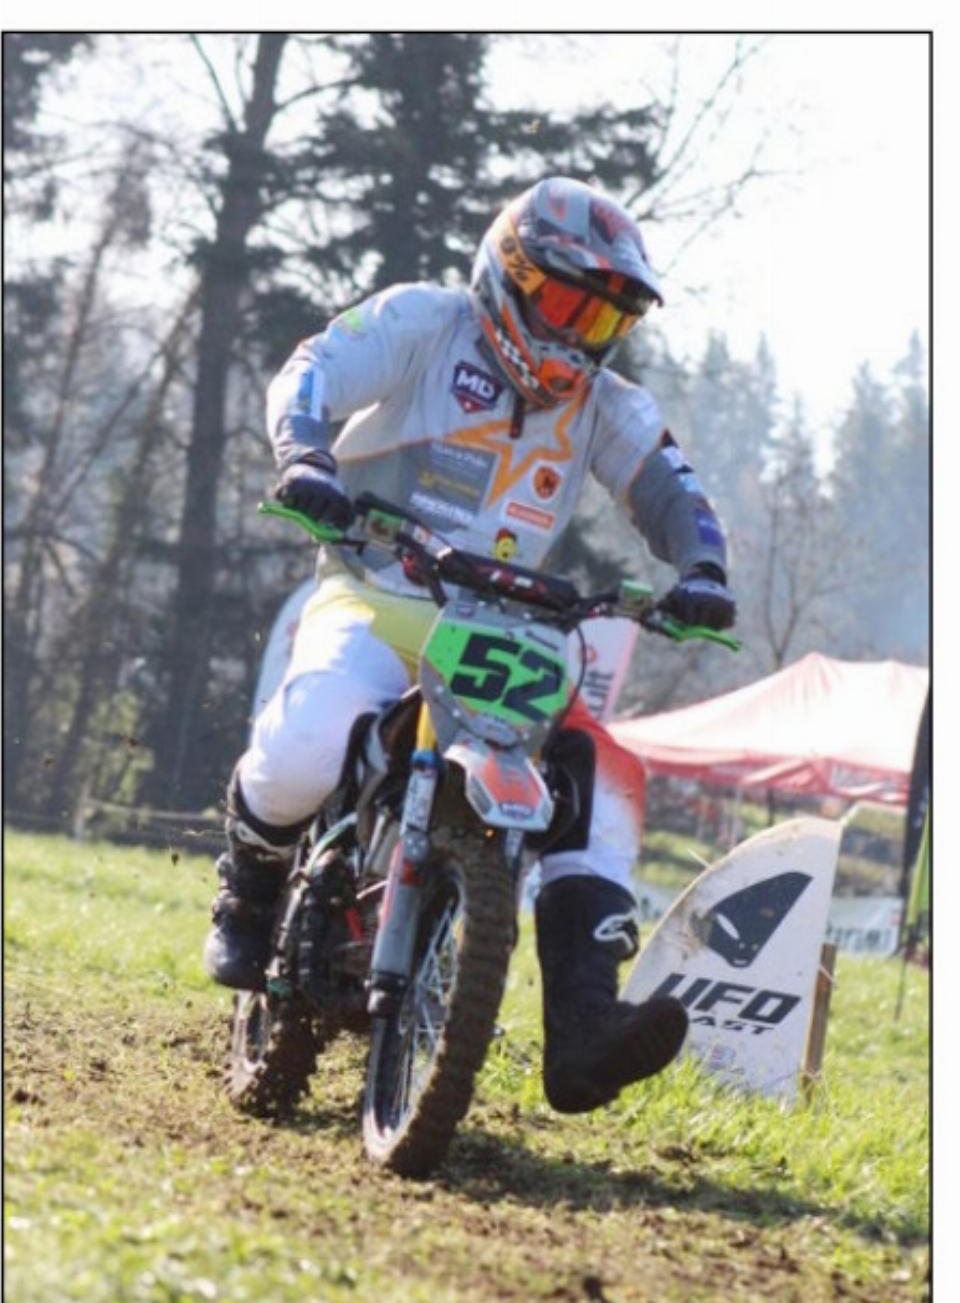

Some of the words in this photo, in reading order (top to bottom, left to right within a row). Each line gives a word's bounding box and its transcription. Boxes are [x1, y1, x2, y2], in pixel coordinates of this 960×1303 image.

[456, 369, 495, 398] MD
[450, 633, 564, 723] 52
[652, 972, 802, 1024] UFO
